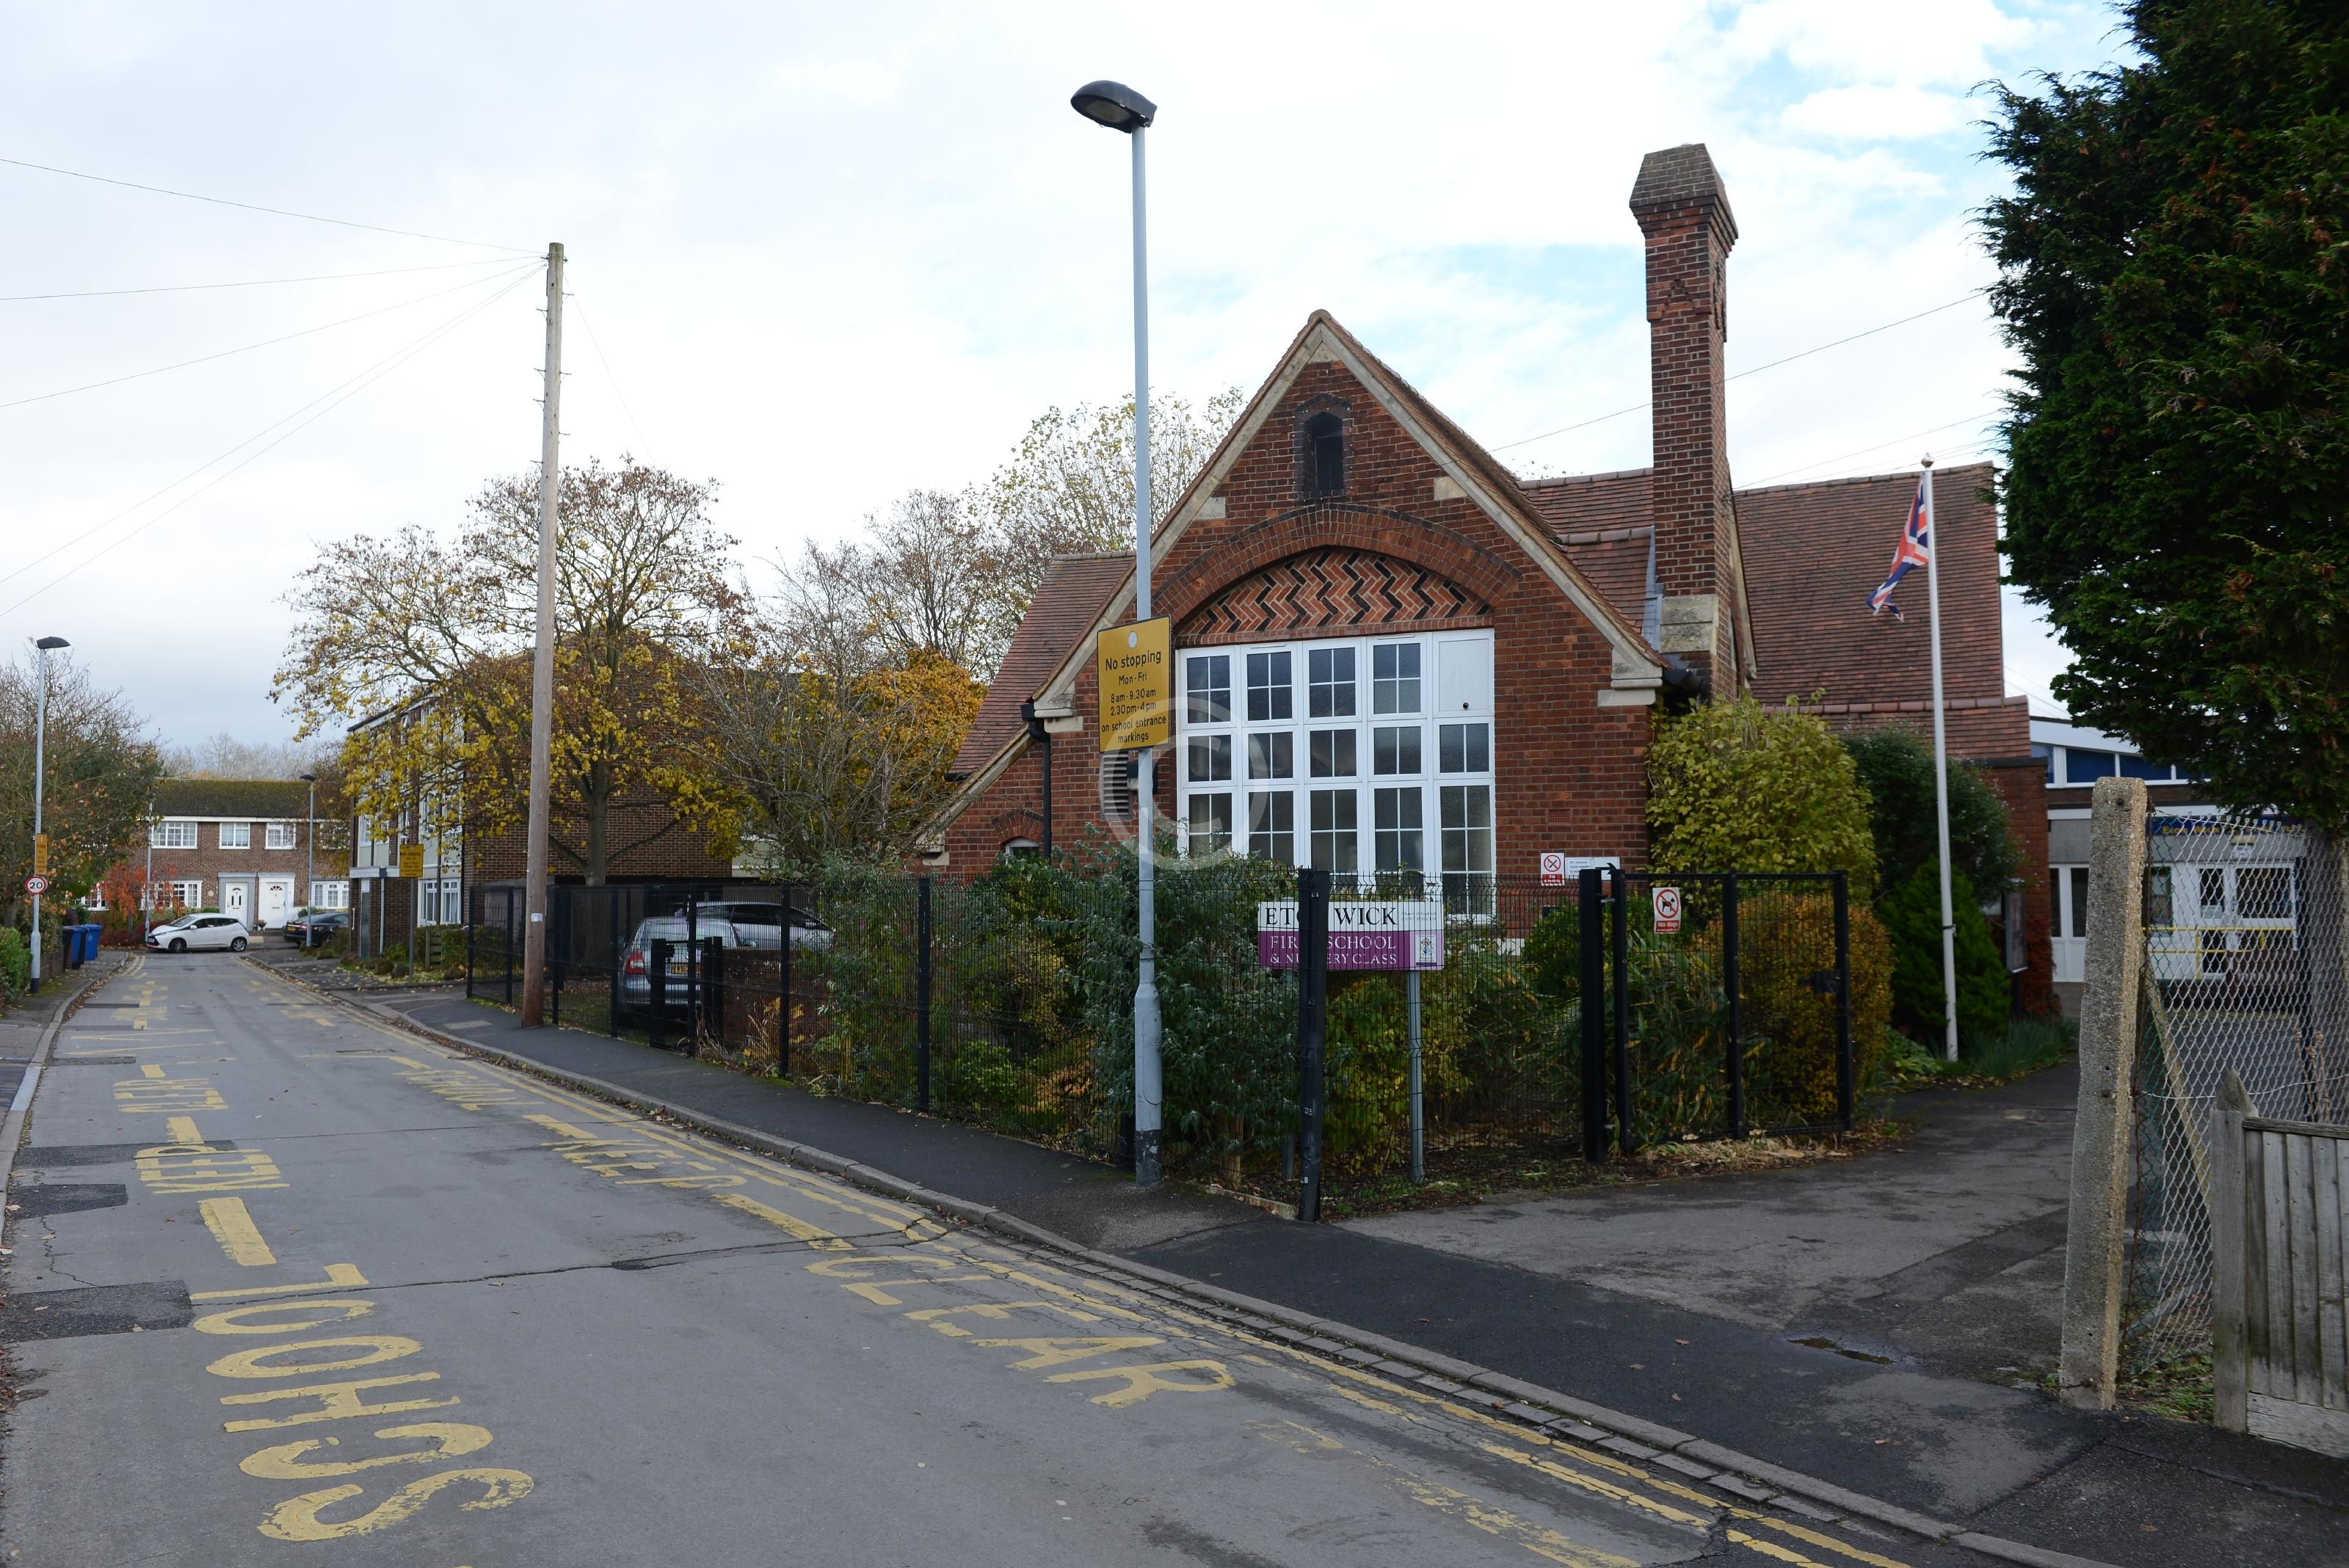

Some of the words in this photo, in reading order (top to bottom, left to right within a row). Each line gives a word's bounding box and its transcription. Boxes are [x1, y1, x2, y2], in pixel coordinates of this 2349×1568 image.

[1105, 658, 1118, 672] No
[1121, 649, 1162, 671] stopping
[1101, 723, 1110, 733] on
[1111, 719, 1133, 731] school
[1136, 715, 1166, 727] entrance
[1117, 732, 1149, 744] markings
[1334, 907, 1398, 926] WICK
[1326, 935, 1397, 949] SCHOOL
[1351, 954, 1398, 965] CLASS
[133, 1144, 290, 1195] KEEP
[540, 1139, 748, 1189] KEEP
[803, 1253, 1236, 1409] CLEAR
[189, 1263, 535, 1542] SCHOOL
